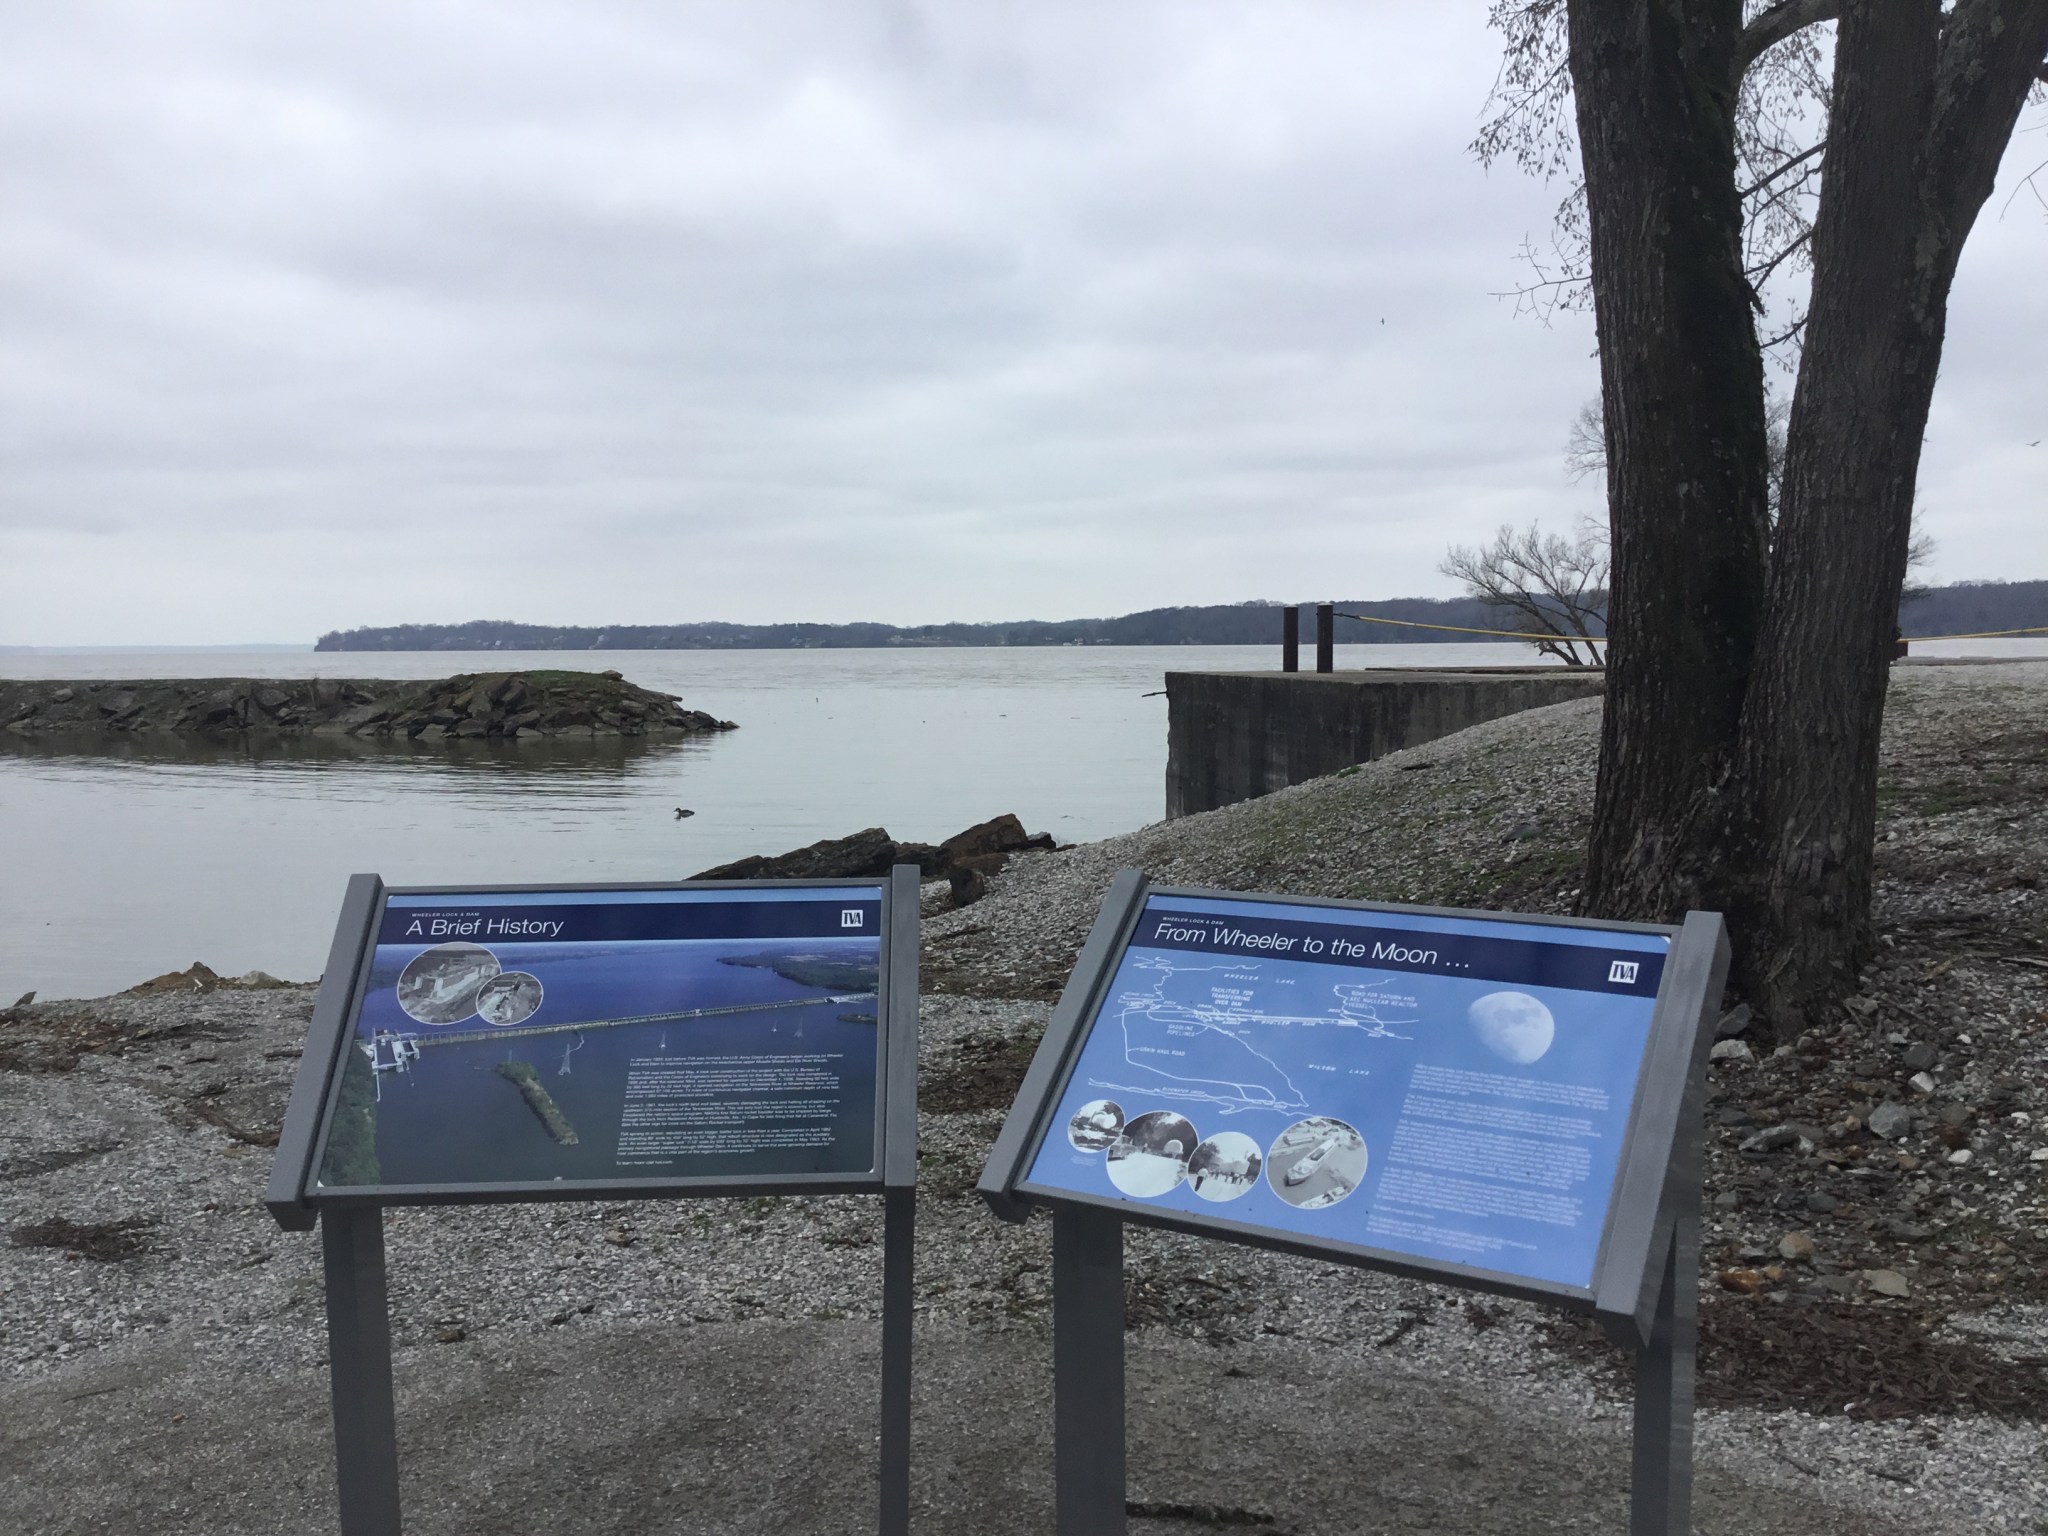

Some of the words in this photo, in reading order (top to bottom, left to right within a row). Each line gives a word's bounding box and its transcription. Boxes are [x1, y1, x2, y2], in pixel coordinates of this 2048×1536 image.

[405, 919, 423, 936] A
[430, 918, 483, 936] Brief
[486, 917, 564, 938] History
[843, 911, 862, 925] TVA
[1154, 923, 1206, 944] From
[1212, 927, 1298, 951] Wheeler
[1302, 936, 1324, 954] to
[1330, 938, 1366, 958] the
[1371, 942, 1439, 965] Moon
[1612, 963, 1636, 980] TVA
